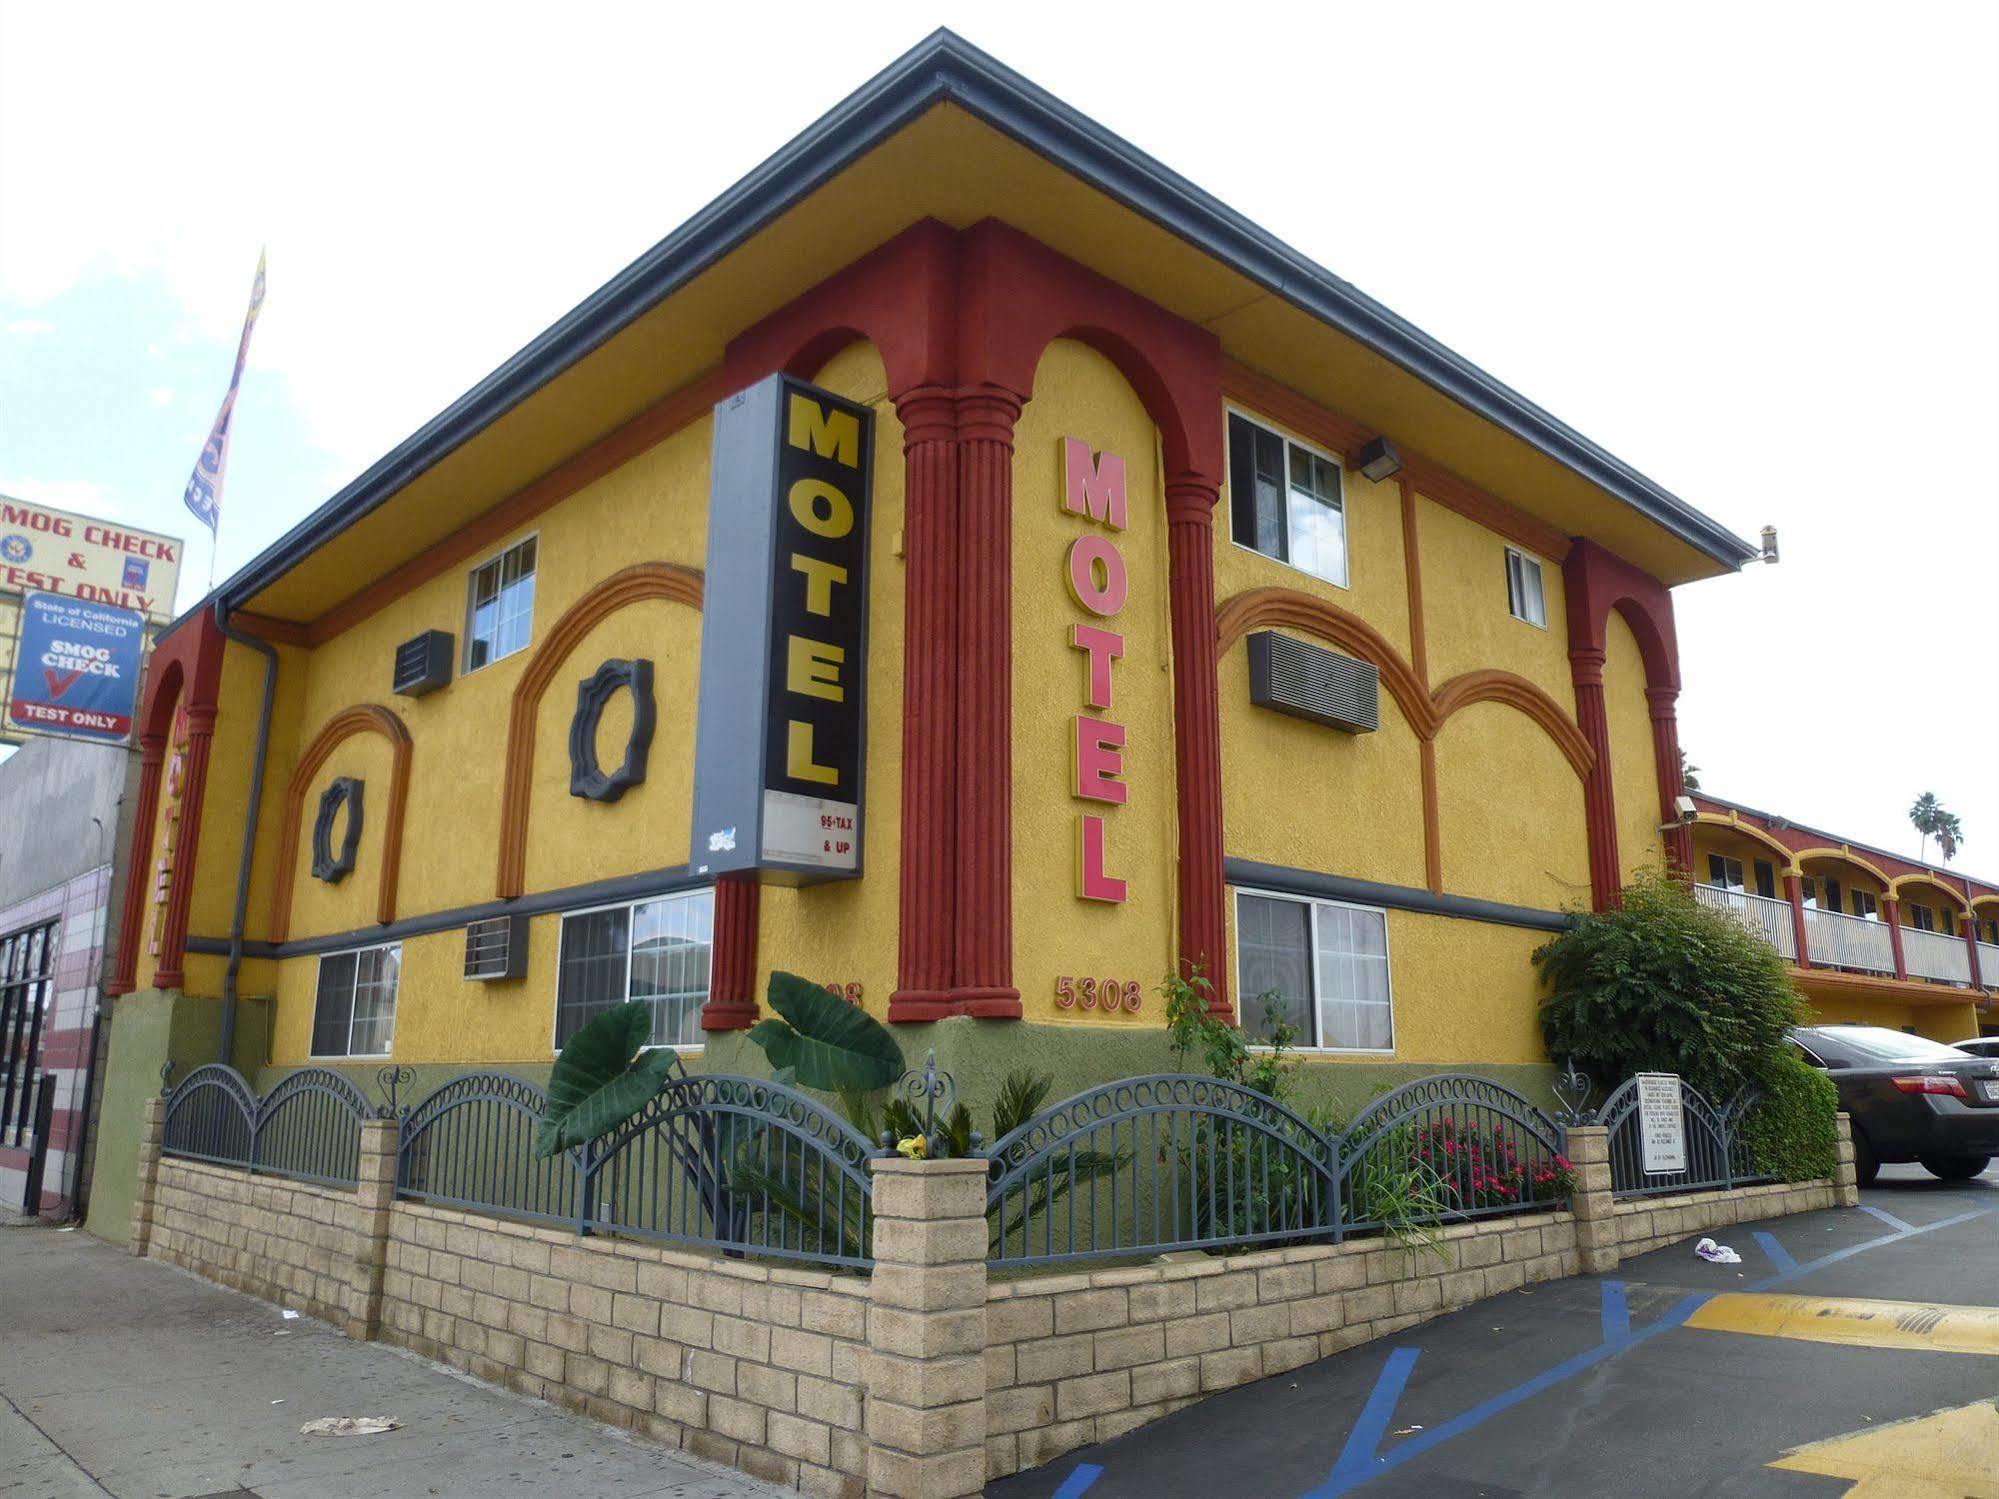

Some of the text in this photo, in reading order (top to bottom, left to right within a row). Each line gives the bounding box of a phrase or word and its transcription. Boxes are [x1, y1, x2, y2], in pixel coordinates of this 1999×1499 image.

[0, 504, 175, 563] MOG CHECK
[67, 552, 87, 571] &
[786, 393, 859, 785] MOTEL
[33, 600, 139, 628] State of California
[43, 613, 127, 637] LICENSED
[50, 640, 111, 662] SMOG
[41, 652, 120, 678] CHECK
[1058, 434, 1128, 903] MOTEL
[25, 704, 117, 729] TEST ONLY
[824, 840, 850, 854] & UP
[1055, 975, 1143, 1013] 5308
